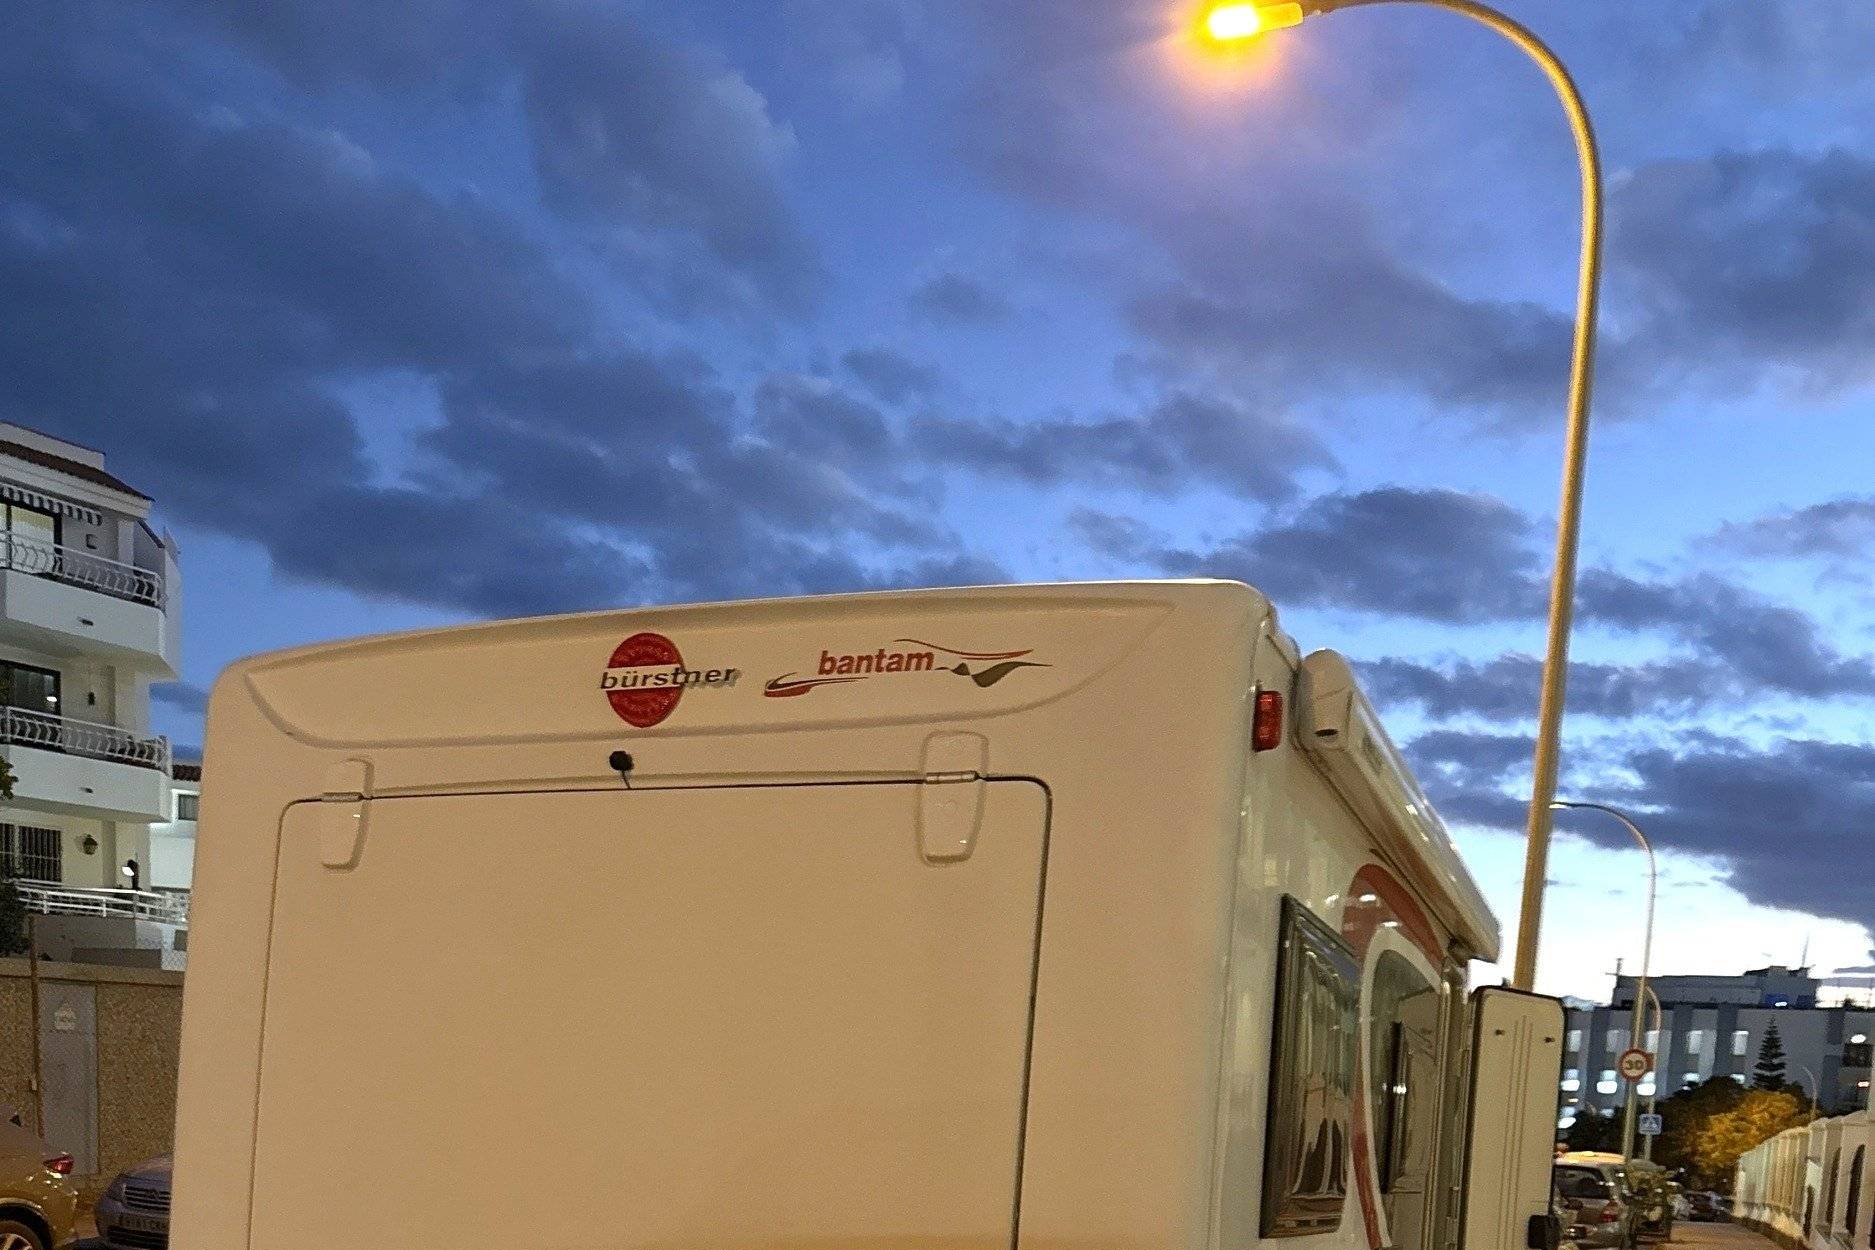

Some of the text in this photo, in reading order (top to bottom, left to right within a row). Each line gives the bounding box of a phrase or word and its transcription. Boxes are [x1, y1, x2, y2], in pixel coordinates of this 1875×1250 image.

[818, 649, 934, 676] bantam
[601, 667, 737, 689] bürstner
[1625, 1058, 1644, 1071] 30
